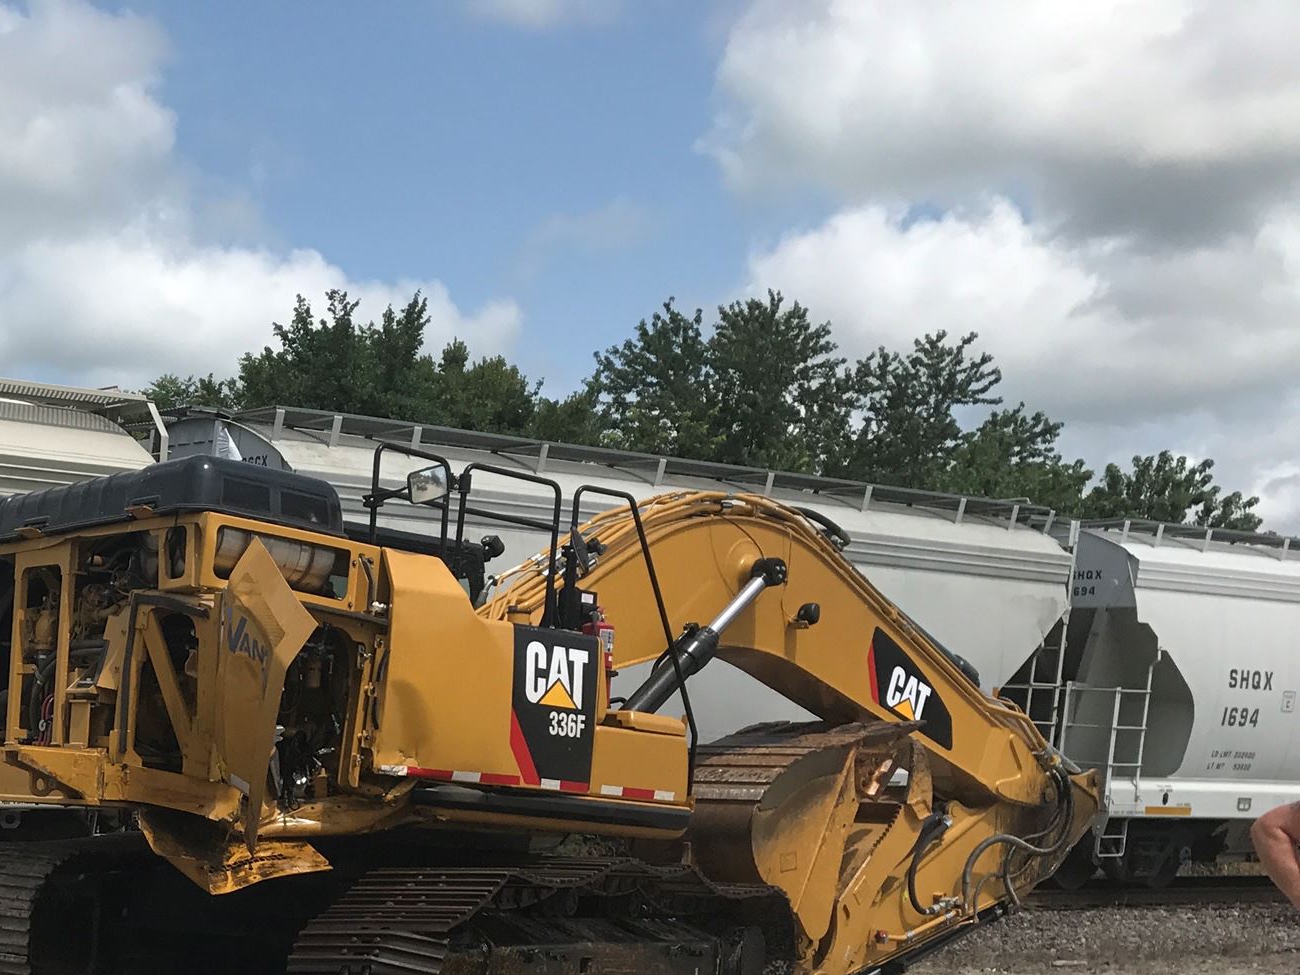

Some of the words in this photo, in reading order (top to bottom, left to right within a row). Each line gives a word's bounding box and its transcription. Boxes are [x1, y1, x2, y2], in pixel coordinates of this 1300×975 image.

[525, 640, 589, 710] CAT
[1228, 668, 1274, 691] SHQX
[886, 665, 932, 721] CAT
[548, 710, 587, 739] 336F
[1221, 706, 1260, 728] 1694
